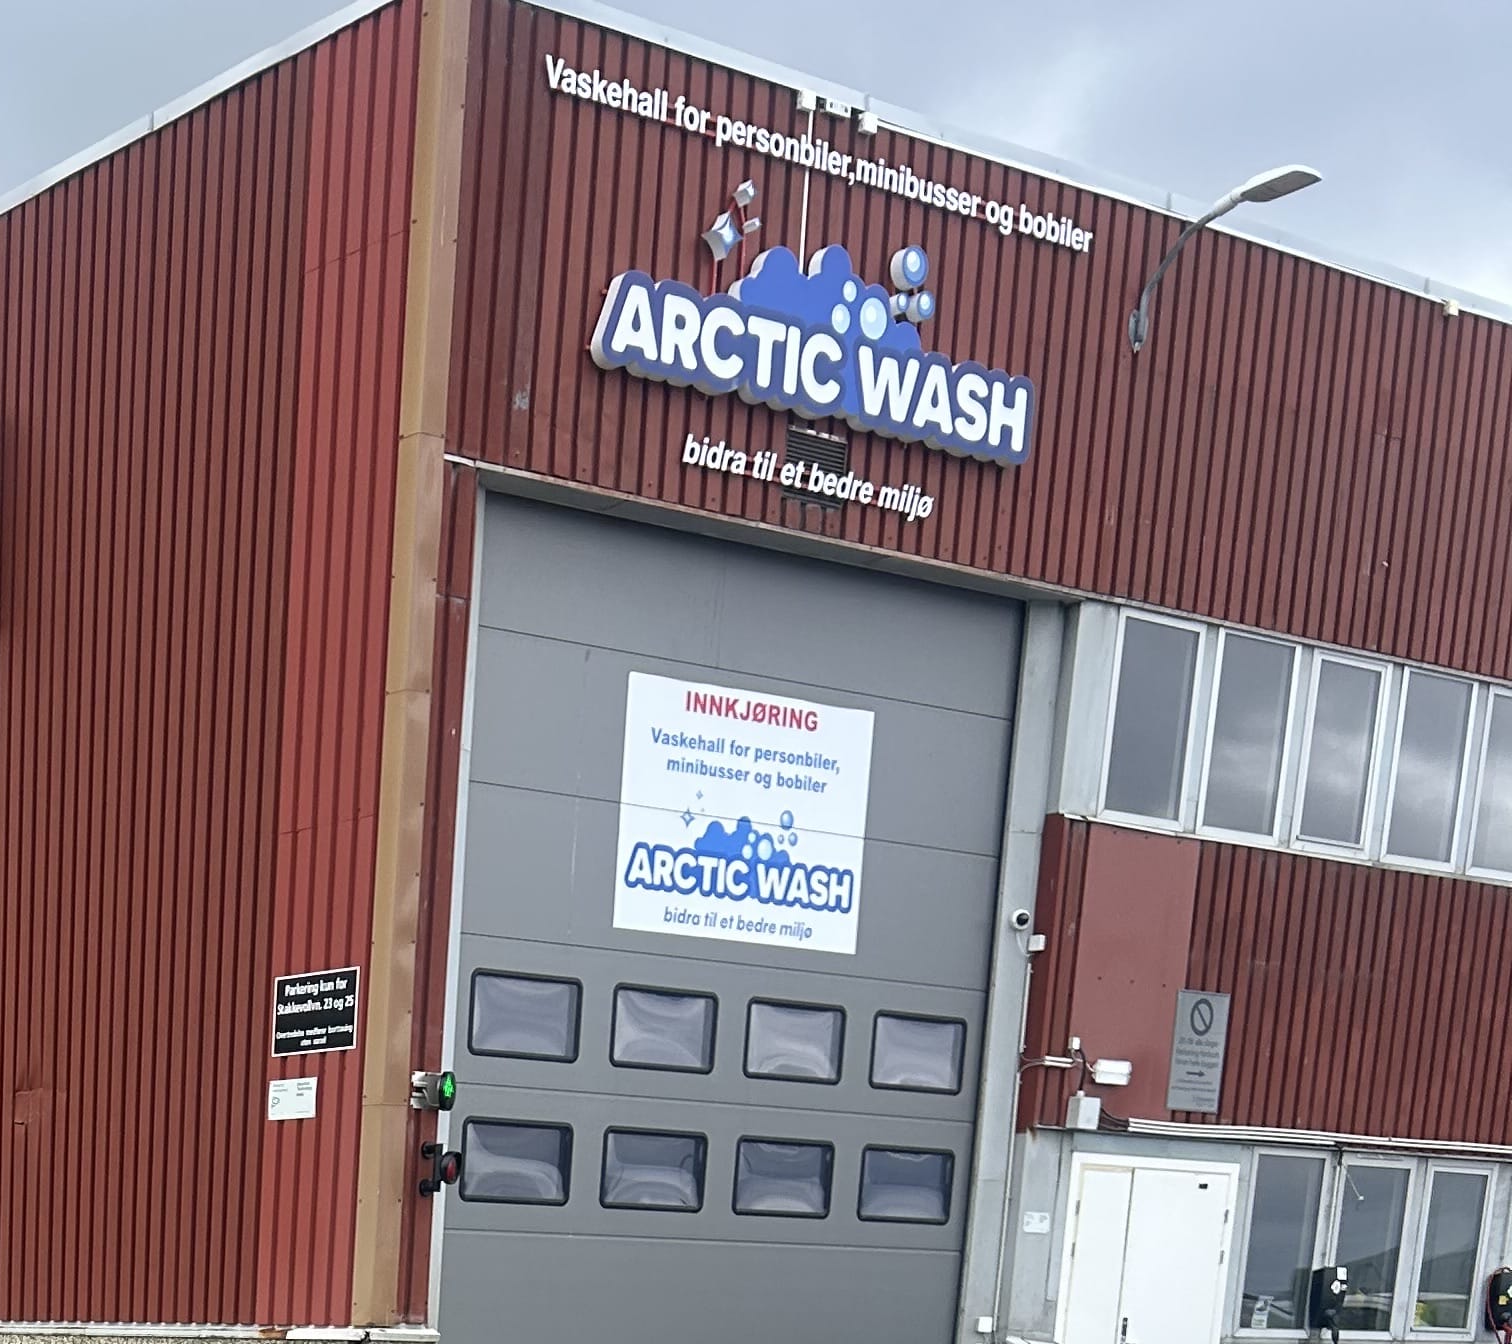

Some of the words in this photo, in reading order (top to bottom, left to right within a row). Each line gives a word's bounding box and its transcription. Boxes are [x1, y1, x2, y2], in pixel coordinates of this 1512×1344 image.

[545, 54, 668, 122] Vaskehall
[675, 95, 712, 133] for
[985, 199, 1016, 236] og
[1019, 203, 1093, 253] bobiler
[610, 284, 841, 405] ARCTIC
[855, 346, 1028, 452] WASH
[683, 434, 746, 475] bidra
[753, 451, 777, 482] til
[781, 462, 805, 489] et
[807, 460, 873, 505] bedre
[877, 483, 934, 521] miljø
[685, 691, 818, 732] INNKJØRING
[651, 727, 725, 754] Vaskehall
[730, 740, 751, 756] for
[754, 746, 840, 774] personbiler,
[666, 758, 750, 782] minibusser
[754, 773, 771, 789] og
[776, 772, 827, 794] bobiler
[628, 847, 748, 896] ARCTIC
[756, 864, 852, 908] WASH
[664, 907, 700, 926] bidra
[704, 912, 716, 928] til
[720, 916, 733, 929] et
[736, 914, 776, 934] bedre
[323, 998, 332, 1010] 23
[334, 998, 344, 1010] og
[345, 995, 354, 1007] 25
